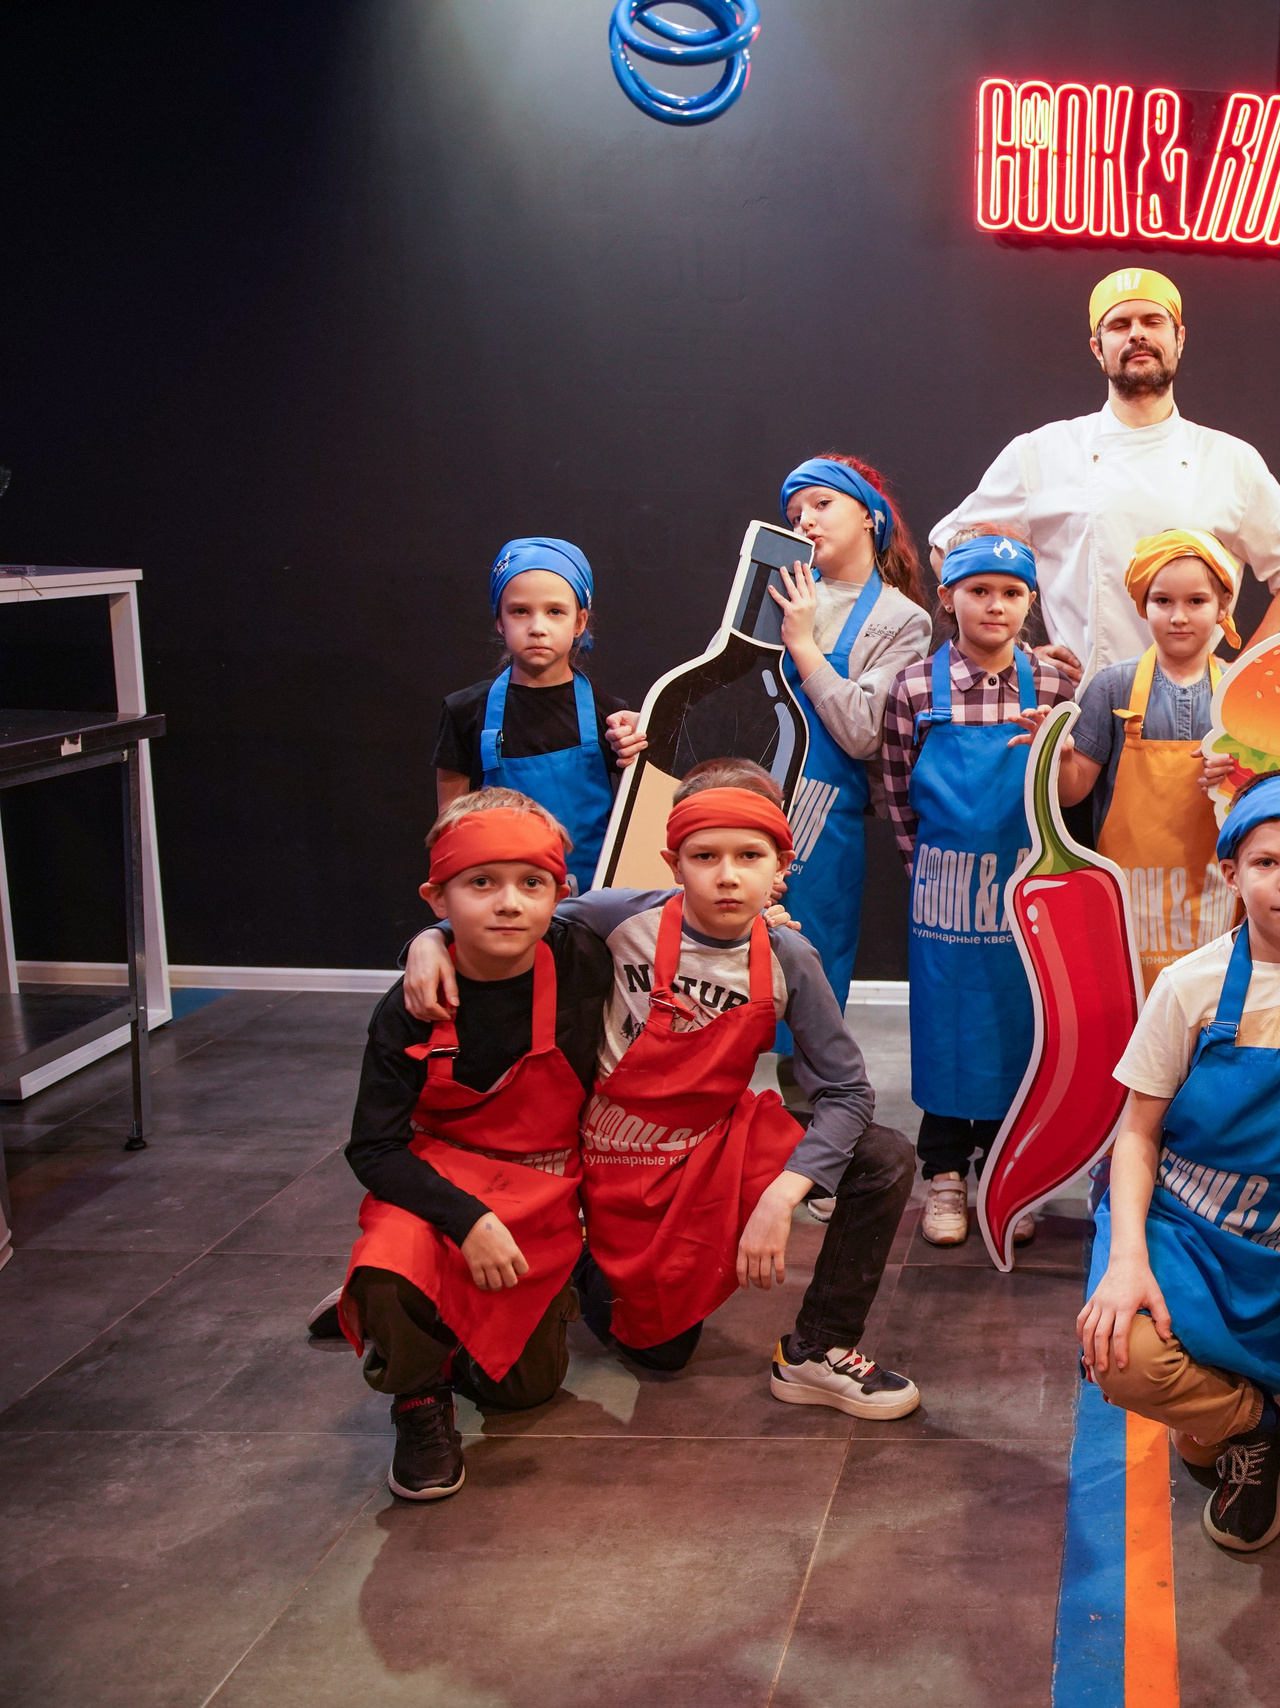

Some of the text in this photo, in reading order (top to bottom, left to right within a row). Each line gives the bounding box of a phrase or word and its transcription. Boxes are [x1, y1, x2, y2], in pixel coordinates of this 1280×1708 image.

[976, 78, 1133, 237] COOK
[1136, 87, 1191, 241] &
[912, 843, 975, 932] COOK
[974, 853, 999, 932] &
[1169, 866, 1194, 951] &
[912, 926, 981, 944] кулинарные
[583, 1153, 666, 1167] кулинарные
